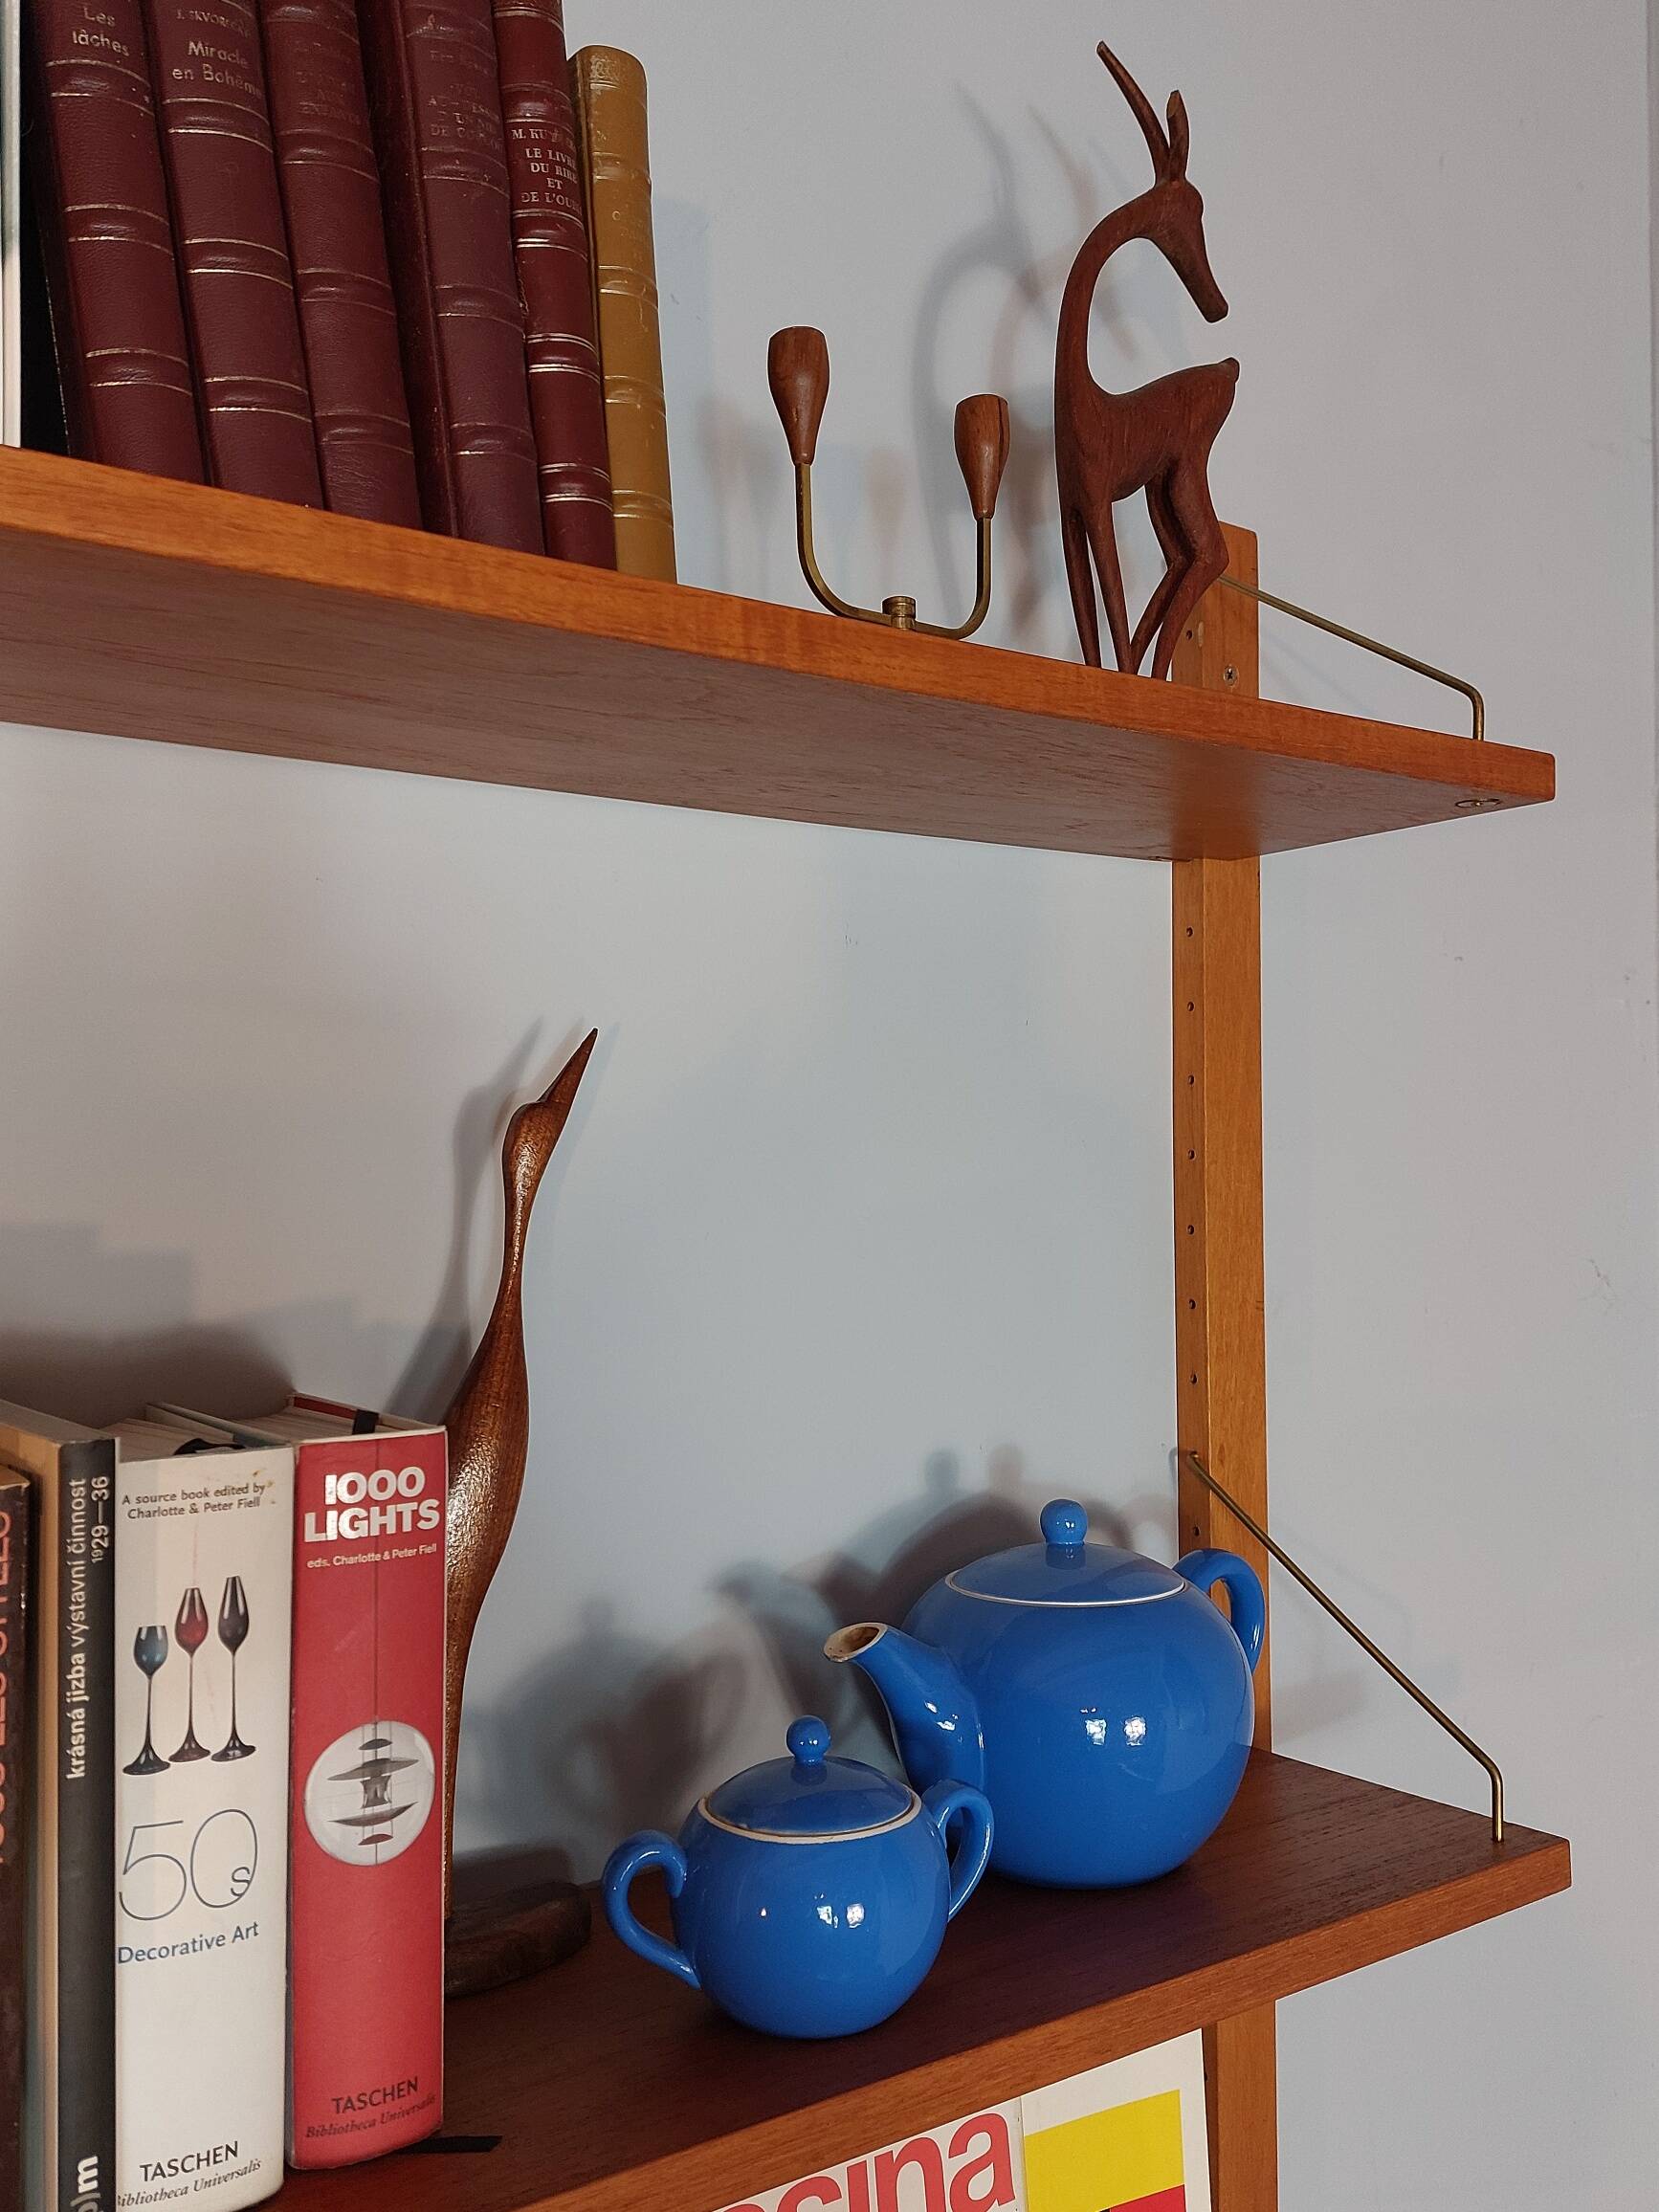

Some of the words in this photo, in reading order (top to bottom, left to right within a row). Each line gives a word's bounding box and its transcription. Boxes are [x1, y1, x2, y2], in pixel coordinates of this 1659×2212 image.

[83, 6, 115, 28] Les
[72, 29, 130, 57] lâches
[188, 40, 249, 69] Miracle
[172, 68, 194, 80] en
[512, 128, 527, 140] M.
[525, 147, 542, 159] LE
[530, 163, 549, 173] DU
[520, 191, 540, 203] DE
[546, 177, 564, 190] ET
[122, 1494, 131, 1505] A
[135, 1492, 177, 1505] source
[181, 1487, 210, 1501] book
[213, 1483, 250, 1497] edited
[253, 1482, 266, 1496] by
[325, 1466, 426, 1506] 1000
[66, 1477, 86, 1554] činnost
[127, 1506, 186, 1519] Charlotte
[188, 1503, 199, 1514] &
[204, 1501, 234, 1513] Peter
[237, 1496, 261, 1509] Fiell
[304, 1498, 441, 1543] LIGHTS
[306, 1557, 331, 1569] eds.
[333, 1552, 381, 1566] Charlotte
[383, 1551, 390, 1560] &
[392, 1547, 418, 1559] Peter
[419, 1543, 437, 1555] Fiell
[66, 1559, 90, 1648] výstavní
[66, 1652, 90, 1703] jizba
[66, 1708, 86, 1780] krásná
[119, 1808, 258, 1921] 50s
[118, 1934, 226, 1964] Decorative
[232, 1921, 259, 1944] Art
[332, 2076, 419, 2114] TASCHEN
[305, 2117, 377, 2138] Bibliotheca
[140, 2140, 239, 2182] TASCHEN
[193, 2157, 261, 2192] Universalis
